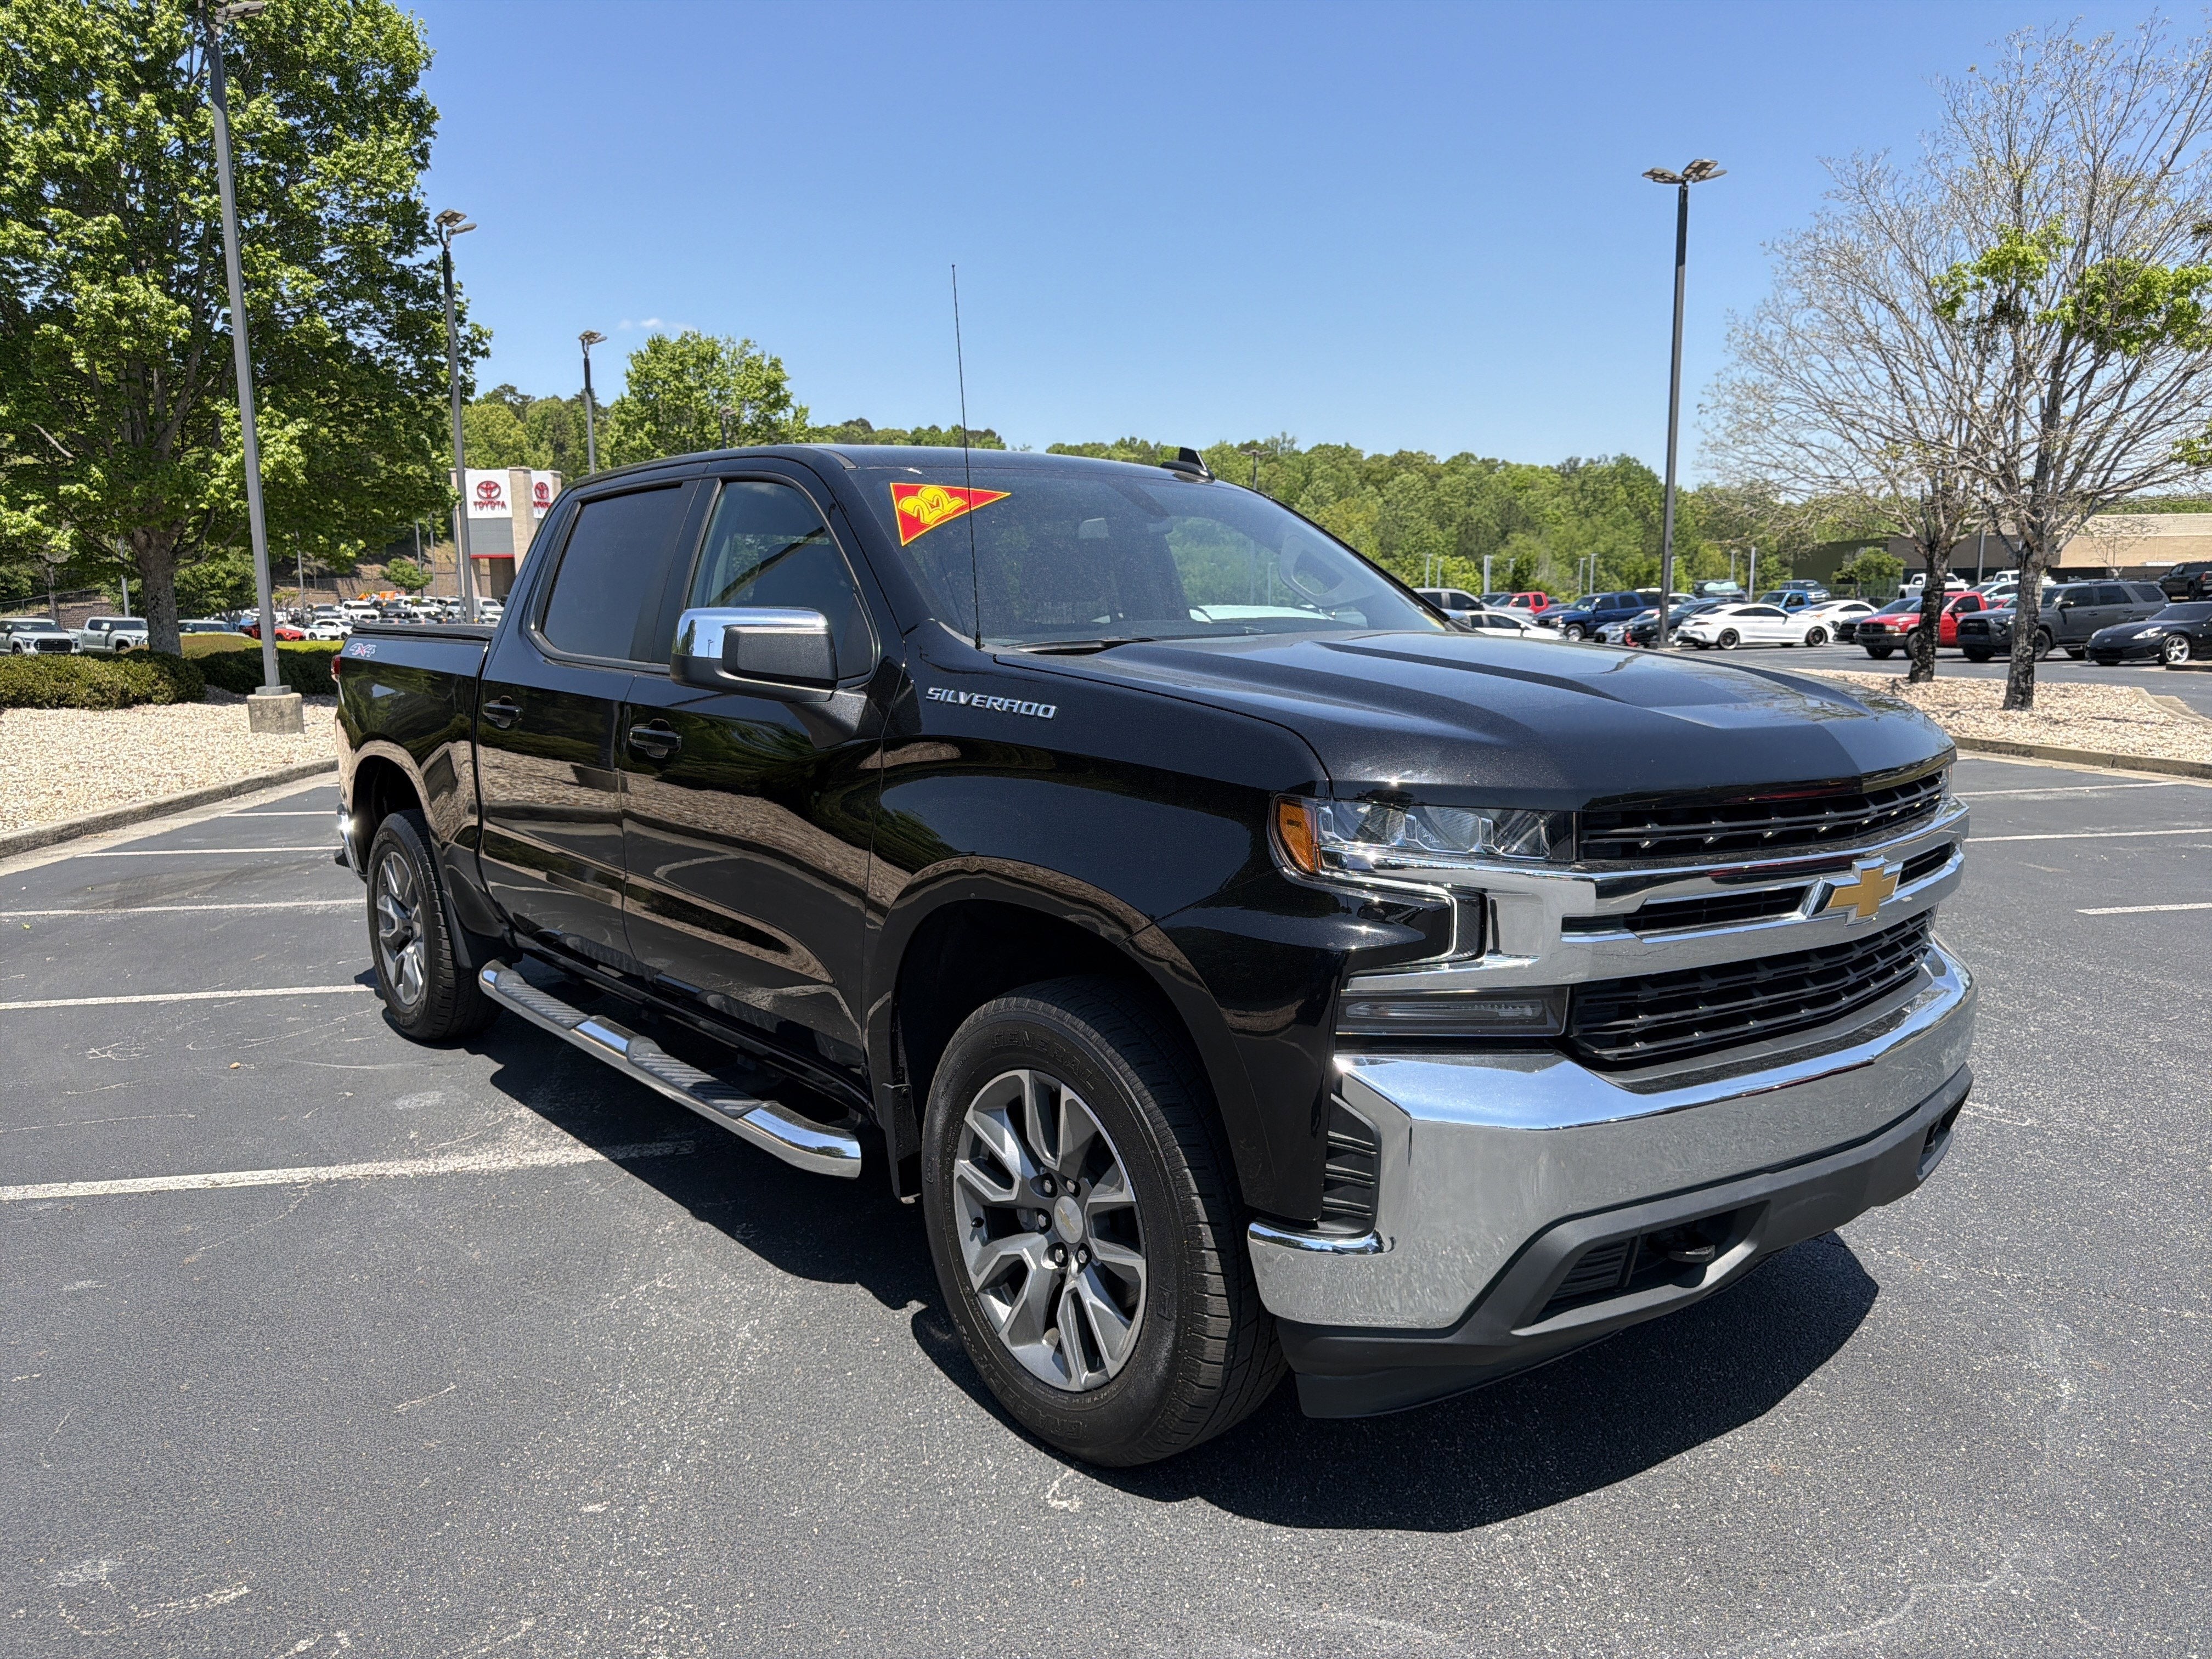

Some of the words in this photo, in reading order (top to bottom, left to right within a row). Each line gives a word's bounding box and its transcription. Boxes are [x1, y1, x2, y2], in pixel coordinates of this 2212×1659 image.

[473, 500, 506, 509] TOYOTA
[898, 487, 968, 526] 22
[926, 687, 1058, 719] SILVERADO
[991, 1029, 1095, 1091] GENERAL
